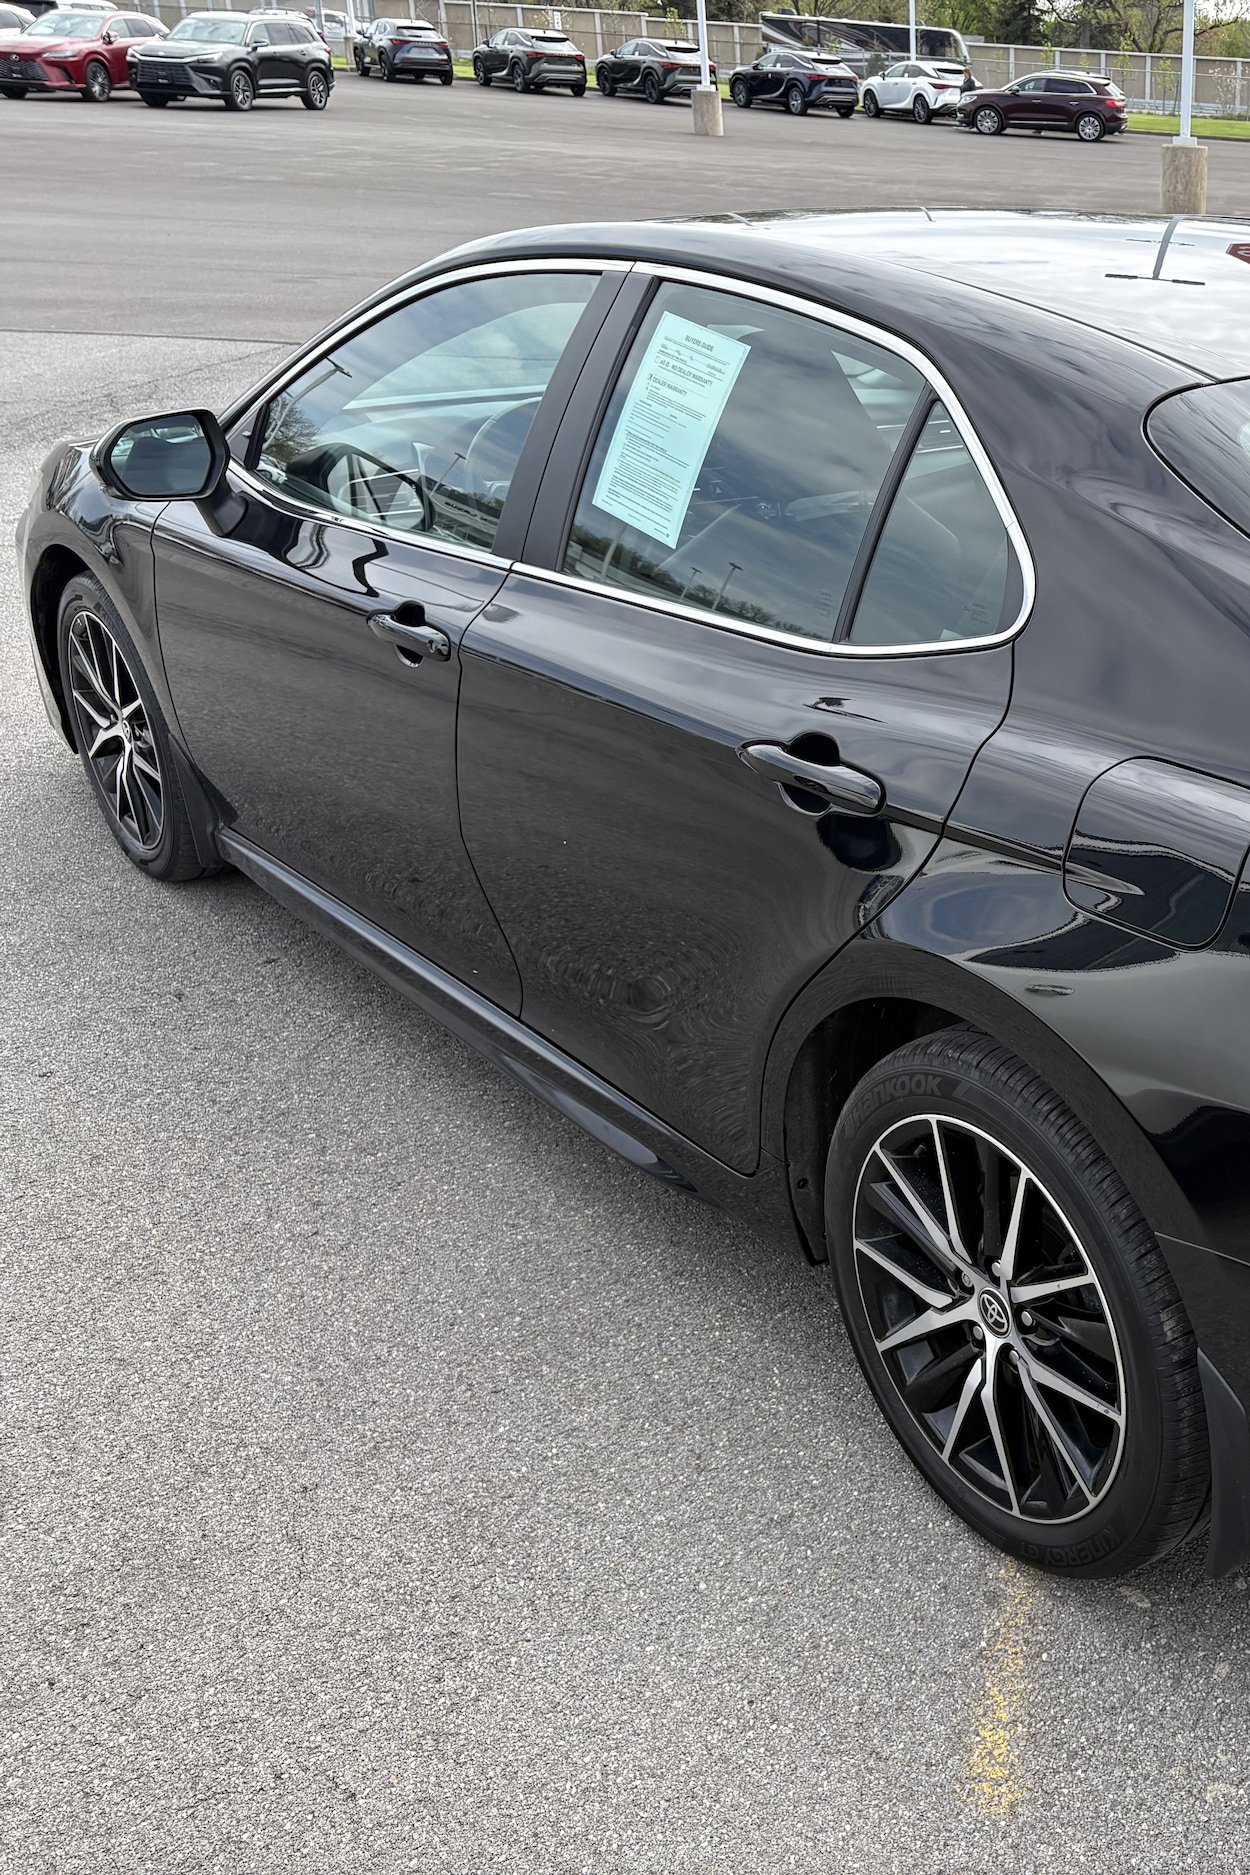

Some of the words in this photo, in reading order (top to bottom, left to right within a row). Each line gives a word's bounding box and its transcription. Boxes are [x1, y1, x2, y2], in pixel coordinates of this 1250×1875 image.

[685, 335, 701, 347] BUYERS
[701, 343, 715, 353] GUIDE
[653, 376, 667, 387] DEALER
[666, 382, 688, 397] WARRANTY
[678, 366, 692, 378] DEALER
[691, 372, 713, 387] WARRANTY
